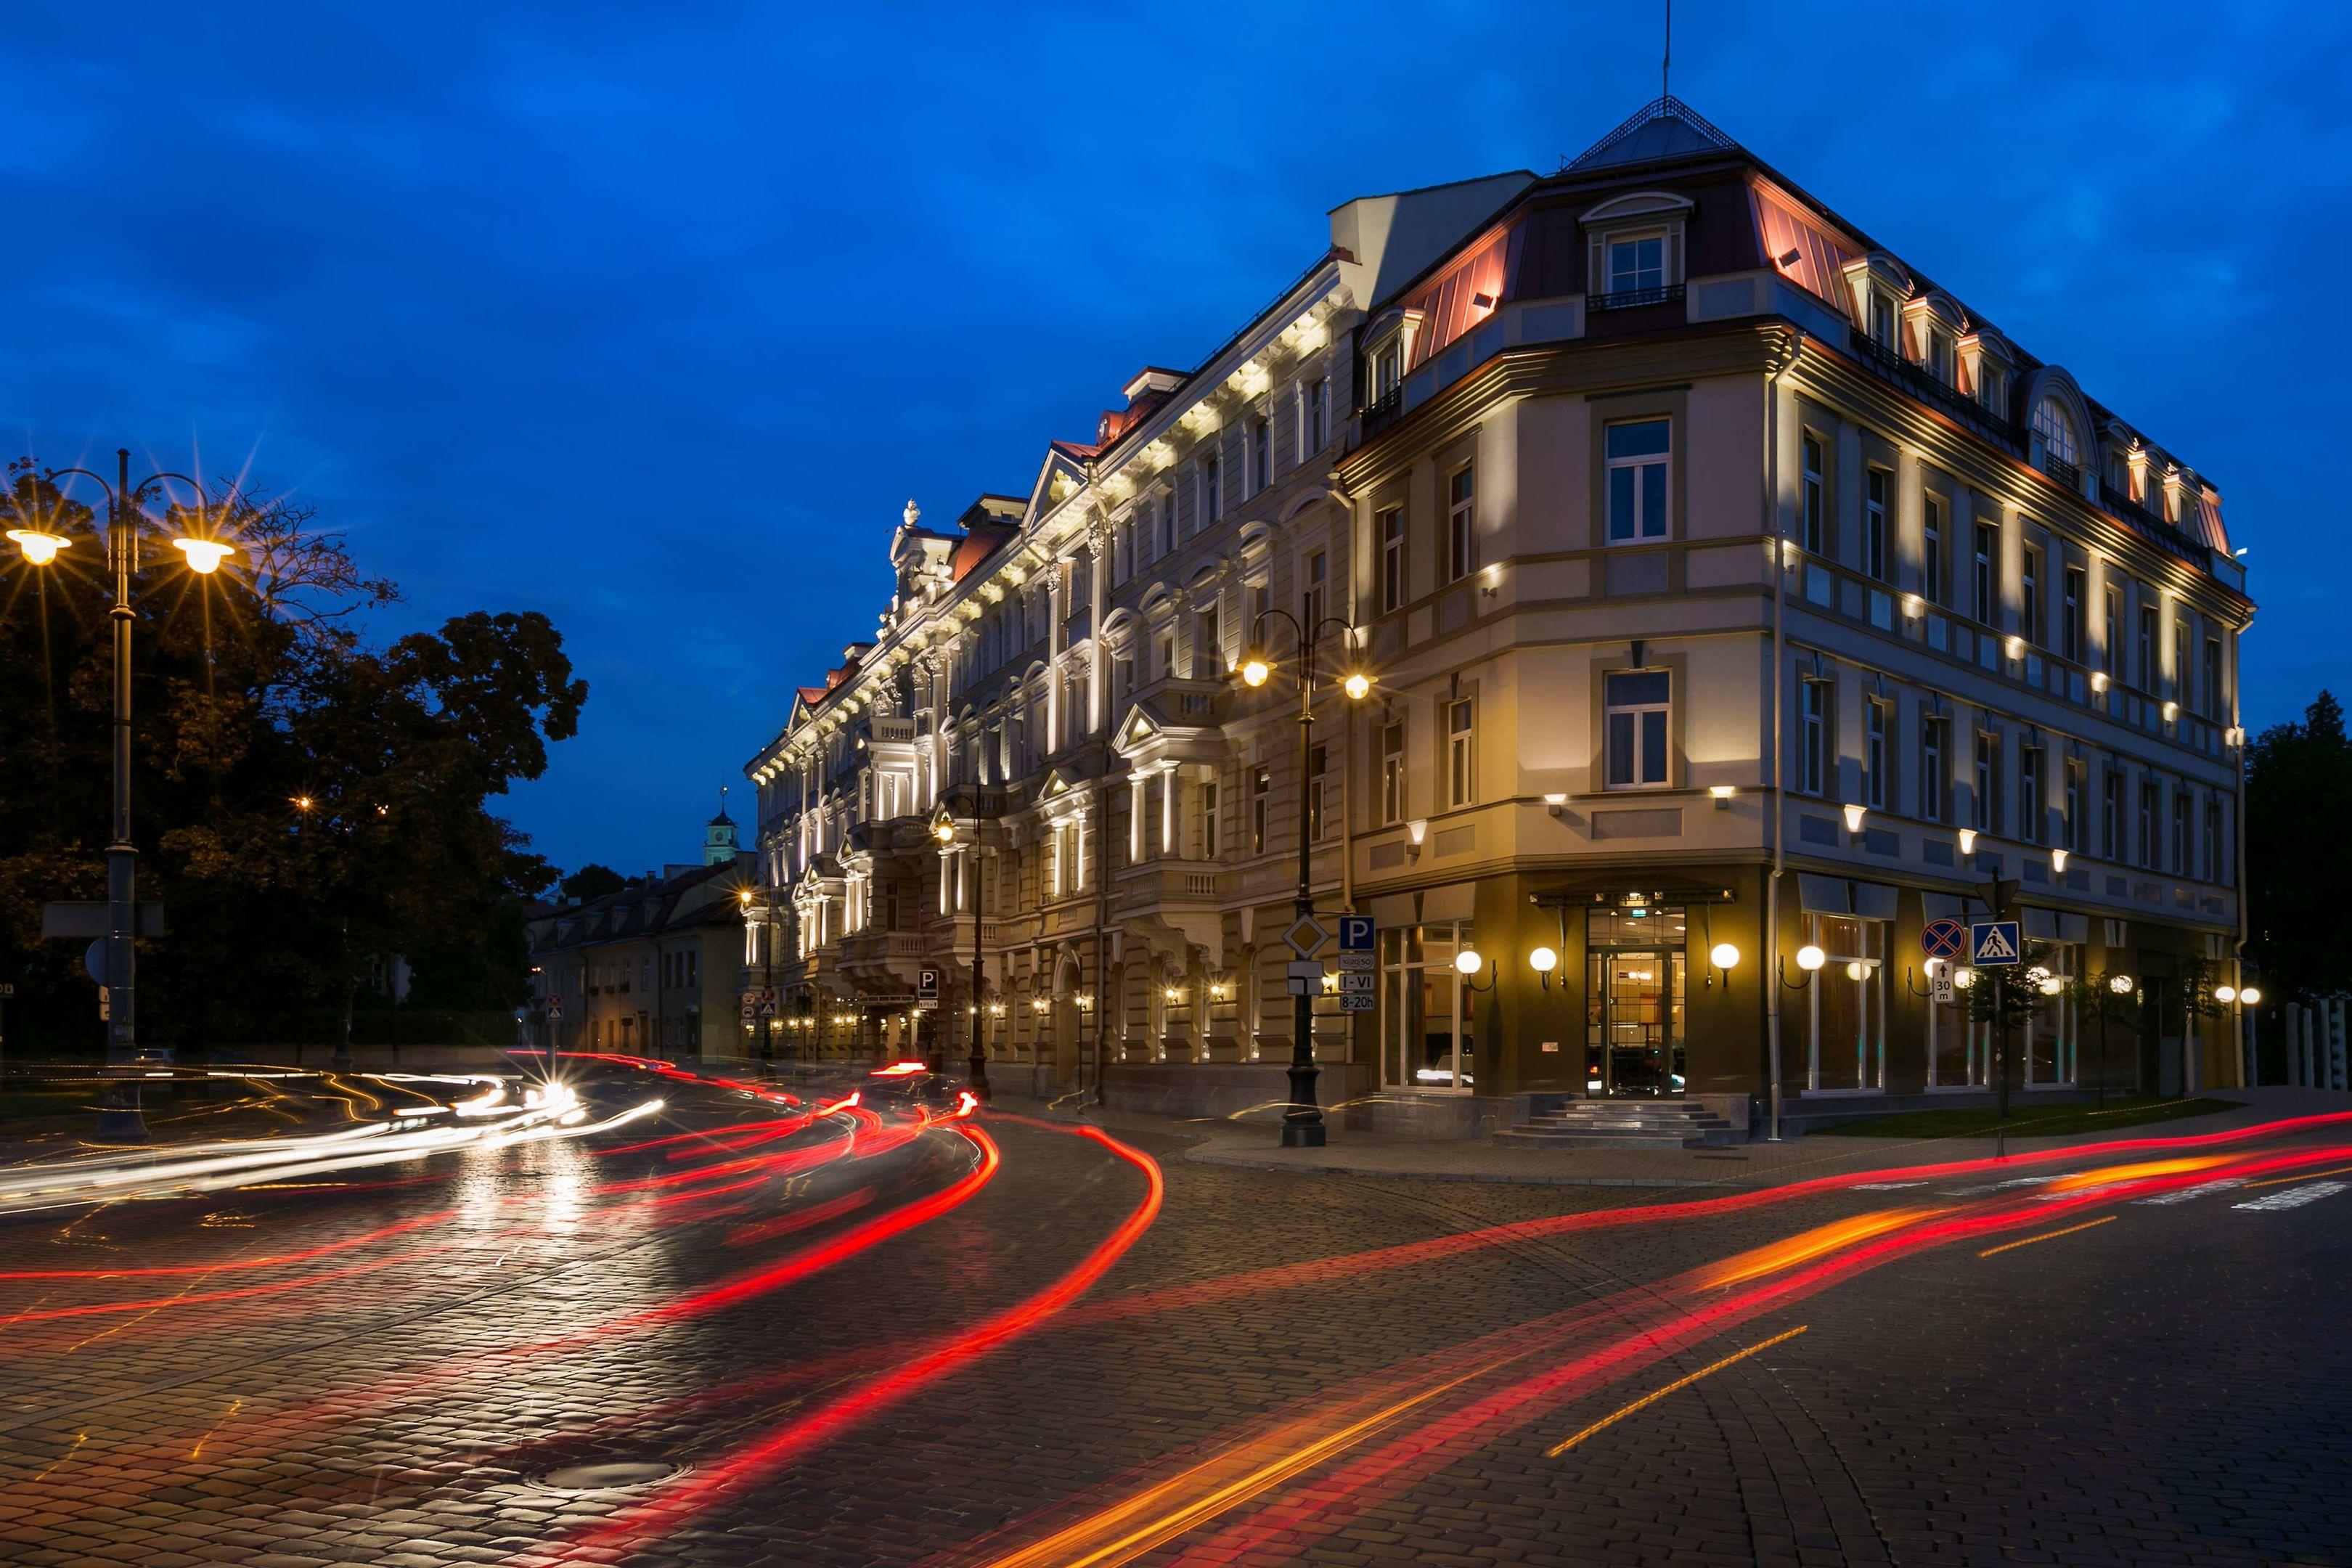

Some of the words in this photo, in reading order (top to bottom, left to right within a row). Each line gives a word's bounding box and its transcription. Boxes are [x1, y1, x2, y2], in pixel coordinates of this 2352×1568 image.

[1349, 920, 1369, 947] P
[923, 973, 934, 987] P
[1937, 981, 1950, 990] 30
[1343, 997, 1373, 1008] 8-20h
